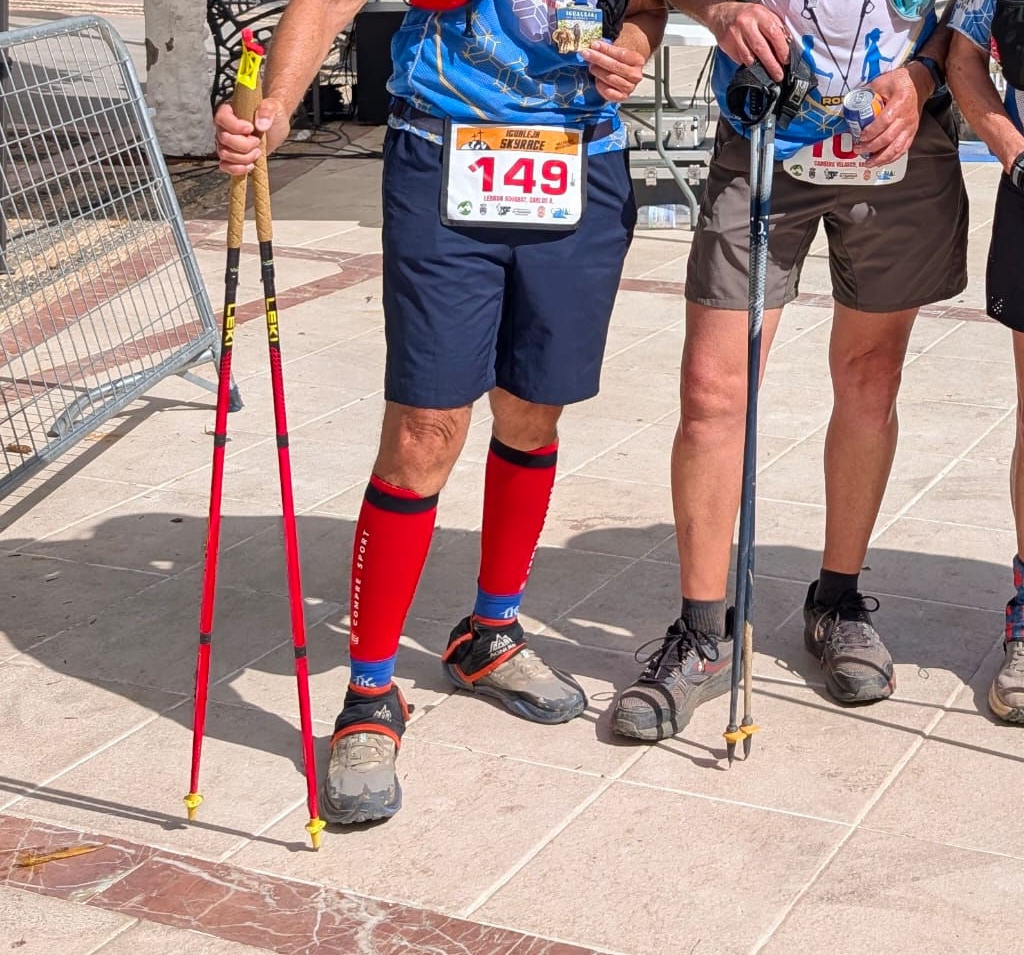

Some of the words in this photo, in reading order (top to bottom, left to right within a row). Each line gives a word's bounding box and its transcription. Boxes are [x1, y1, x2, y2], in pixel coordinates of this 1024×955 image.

[499, 138, 546, 151] SKYRACE
[467, 157, 568, 196] 149
[225, 304, 236, 346] LEKI
[266, 297, 279, 342] LEKI
[356, 530, 370, 570] SPORT
